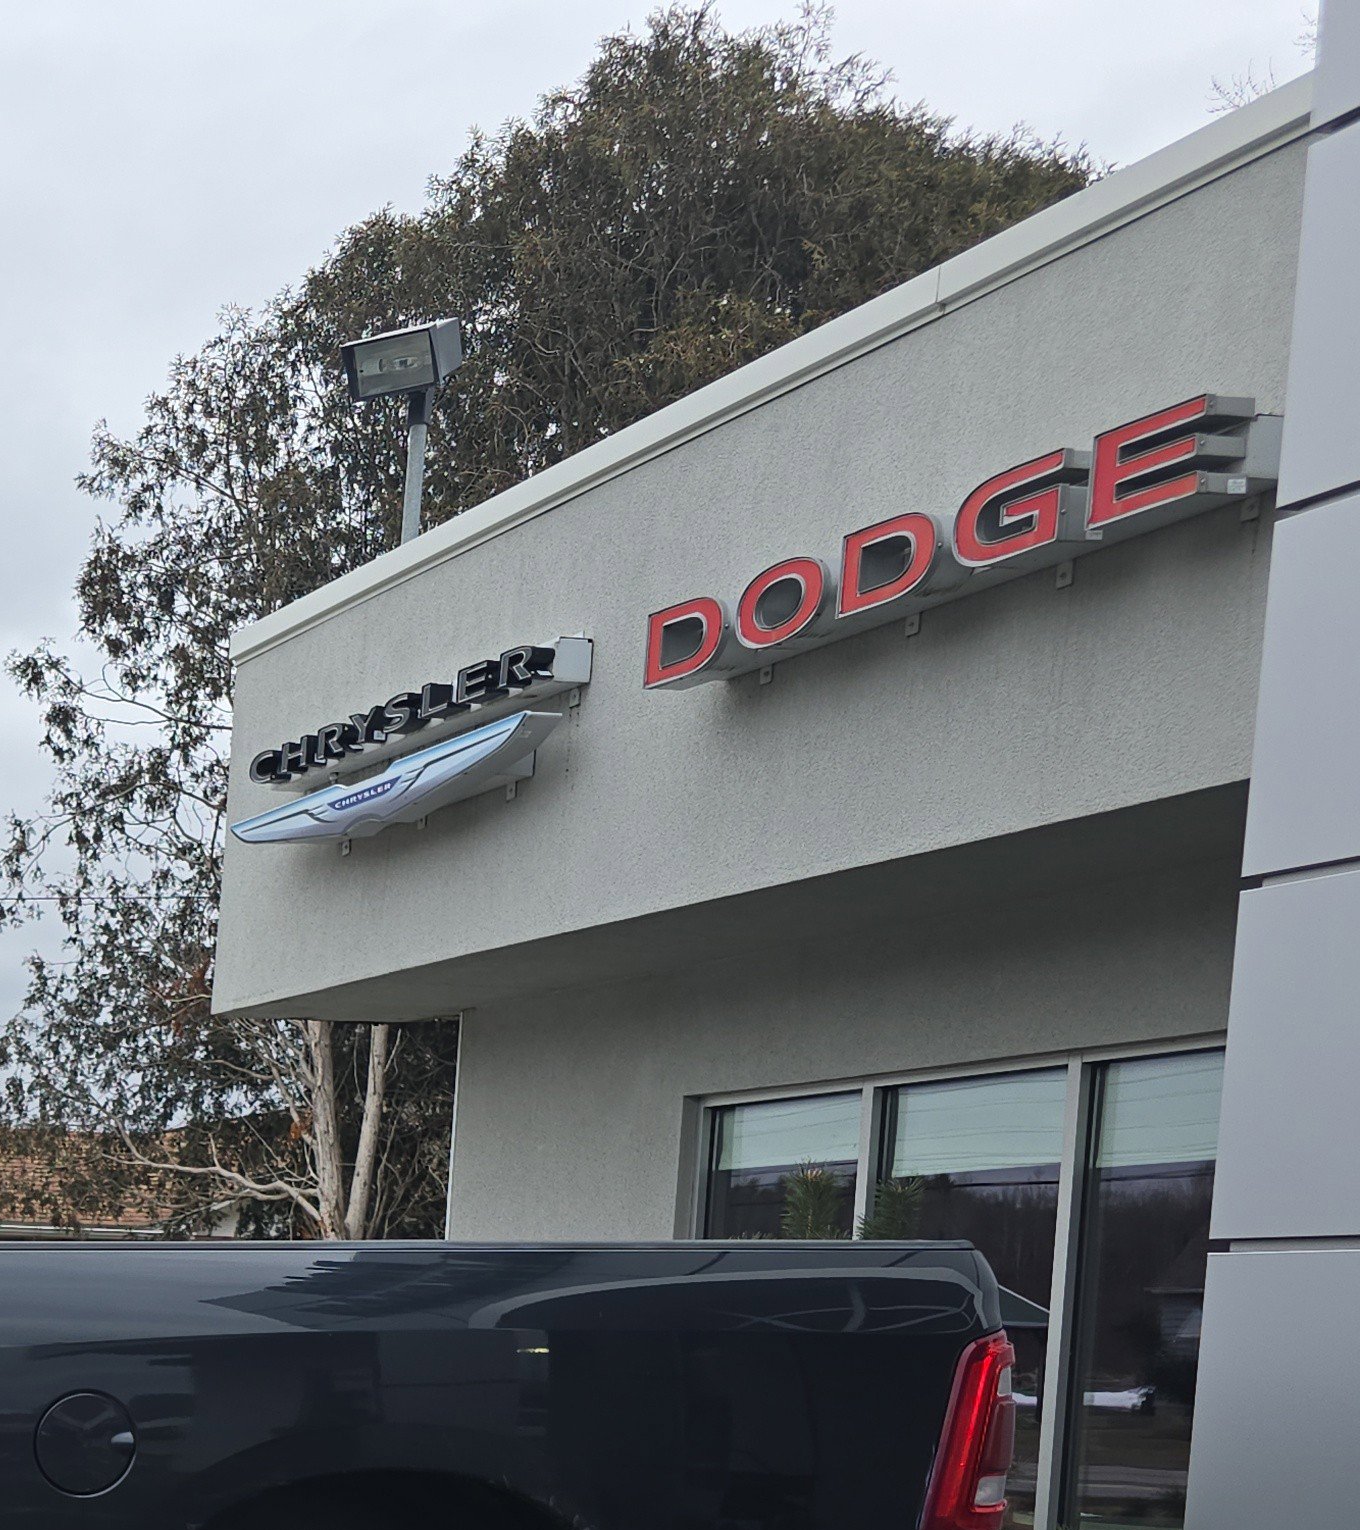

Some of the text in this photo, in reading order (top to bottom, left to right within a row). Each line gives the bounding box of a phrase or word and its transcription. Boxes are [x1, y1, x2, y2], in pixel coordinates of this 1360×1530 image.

[643, 394, 1214, 689] DODGE
[249, 646, 534, 783] CHRYSLER
[333, 782, 392, 809] CHRYSLER
